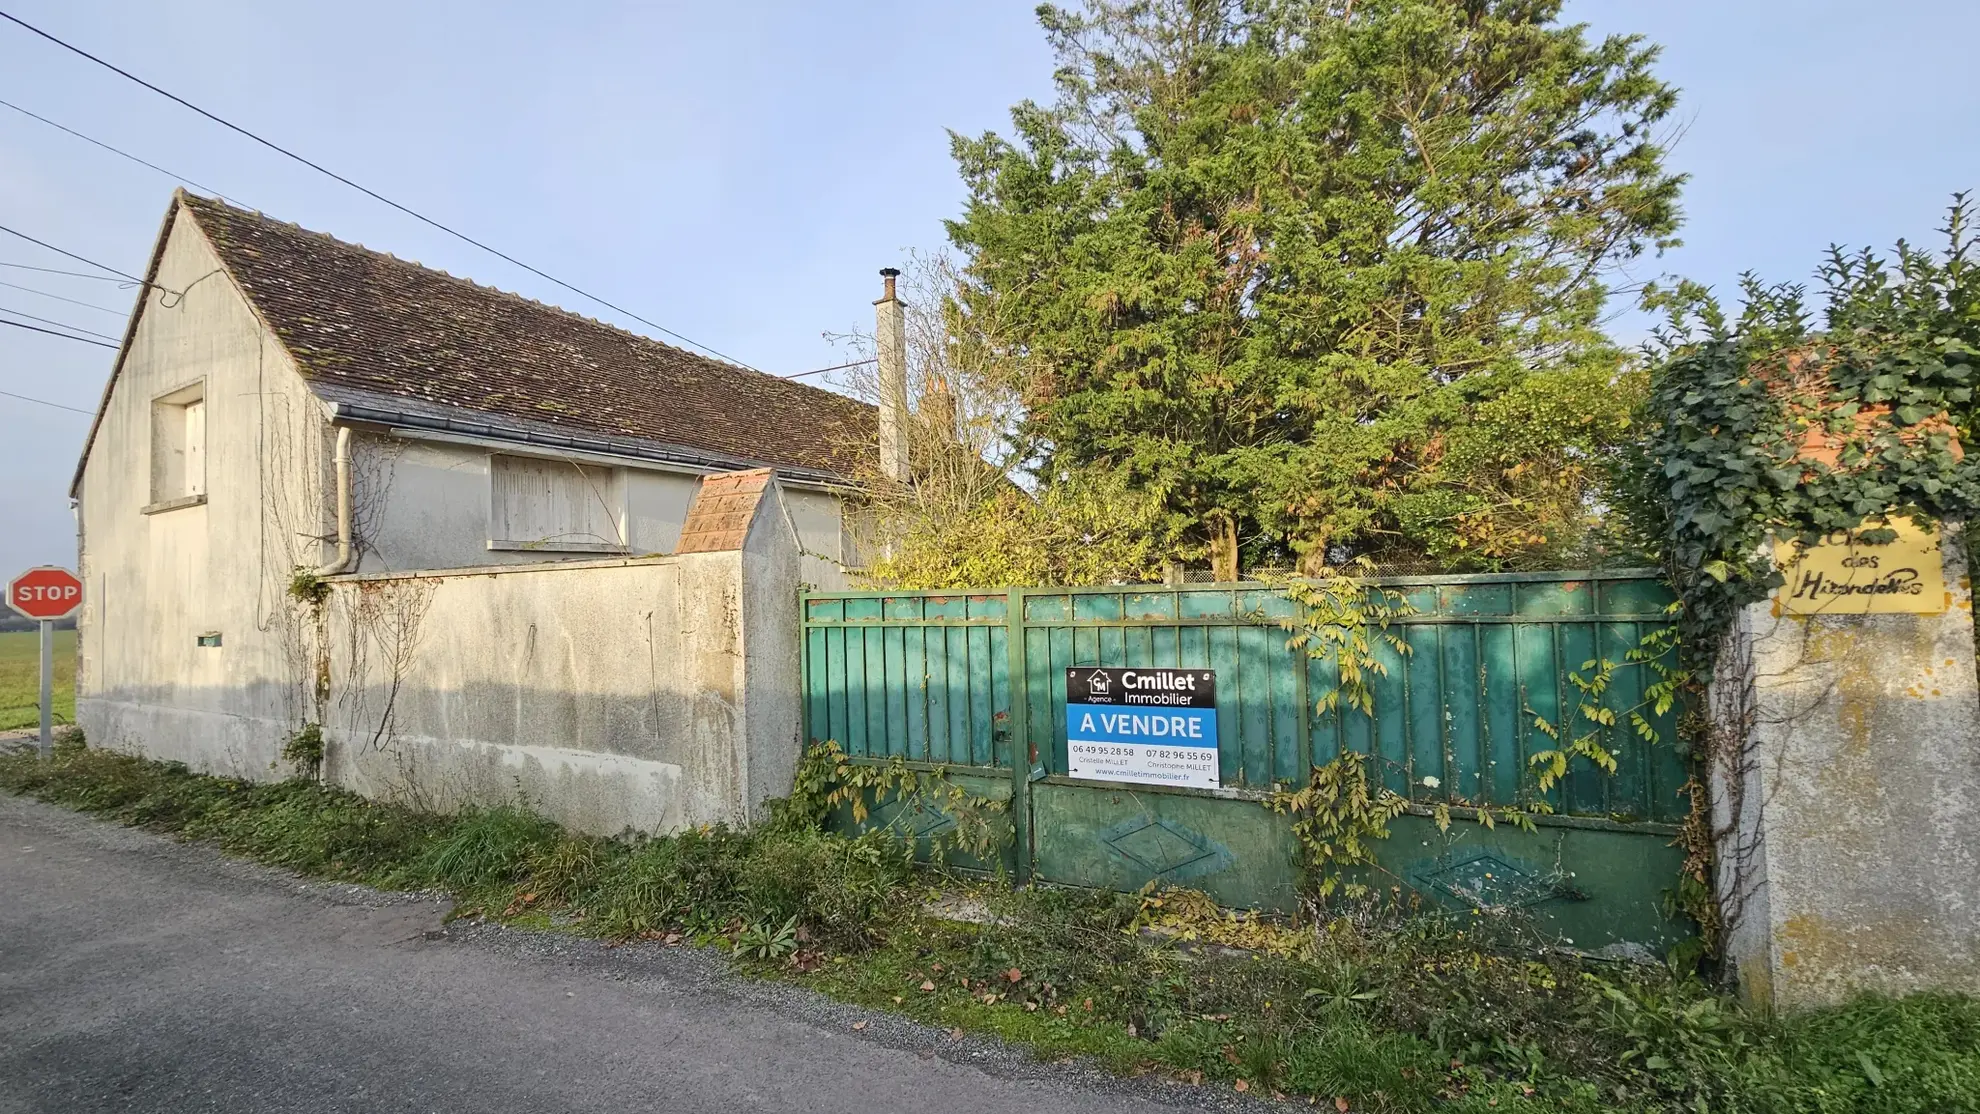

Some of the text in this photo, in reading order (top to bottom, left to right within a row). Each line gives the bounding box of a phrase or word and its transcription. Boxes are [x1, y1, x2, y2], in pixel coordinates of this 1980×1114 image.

[1841, 551, 1880, 568] des
[18, 586, 78, 601] STOP
[1121, 671, 1196, 691] Cmillet
[1087, 695, 1113, 704] Agence
[1124, 692, 1193, 706] Immobilier
[1080, 713, 1203, 738] A VENDRE
[1072, 745, 1134, 757] 06 49 95 28 58
[1146, 749, 1213, 761] 07 82 96 55 69
[1186, 763, 1212, 771] MILLET
[1095, 768, 1190, 781] www.cmilletimmobilier.fr
